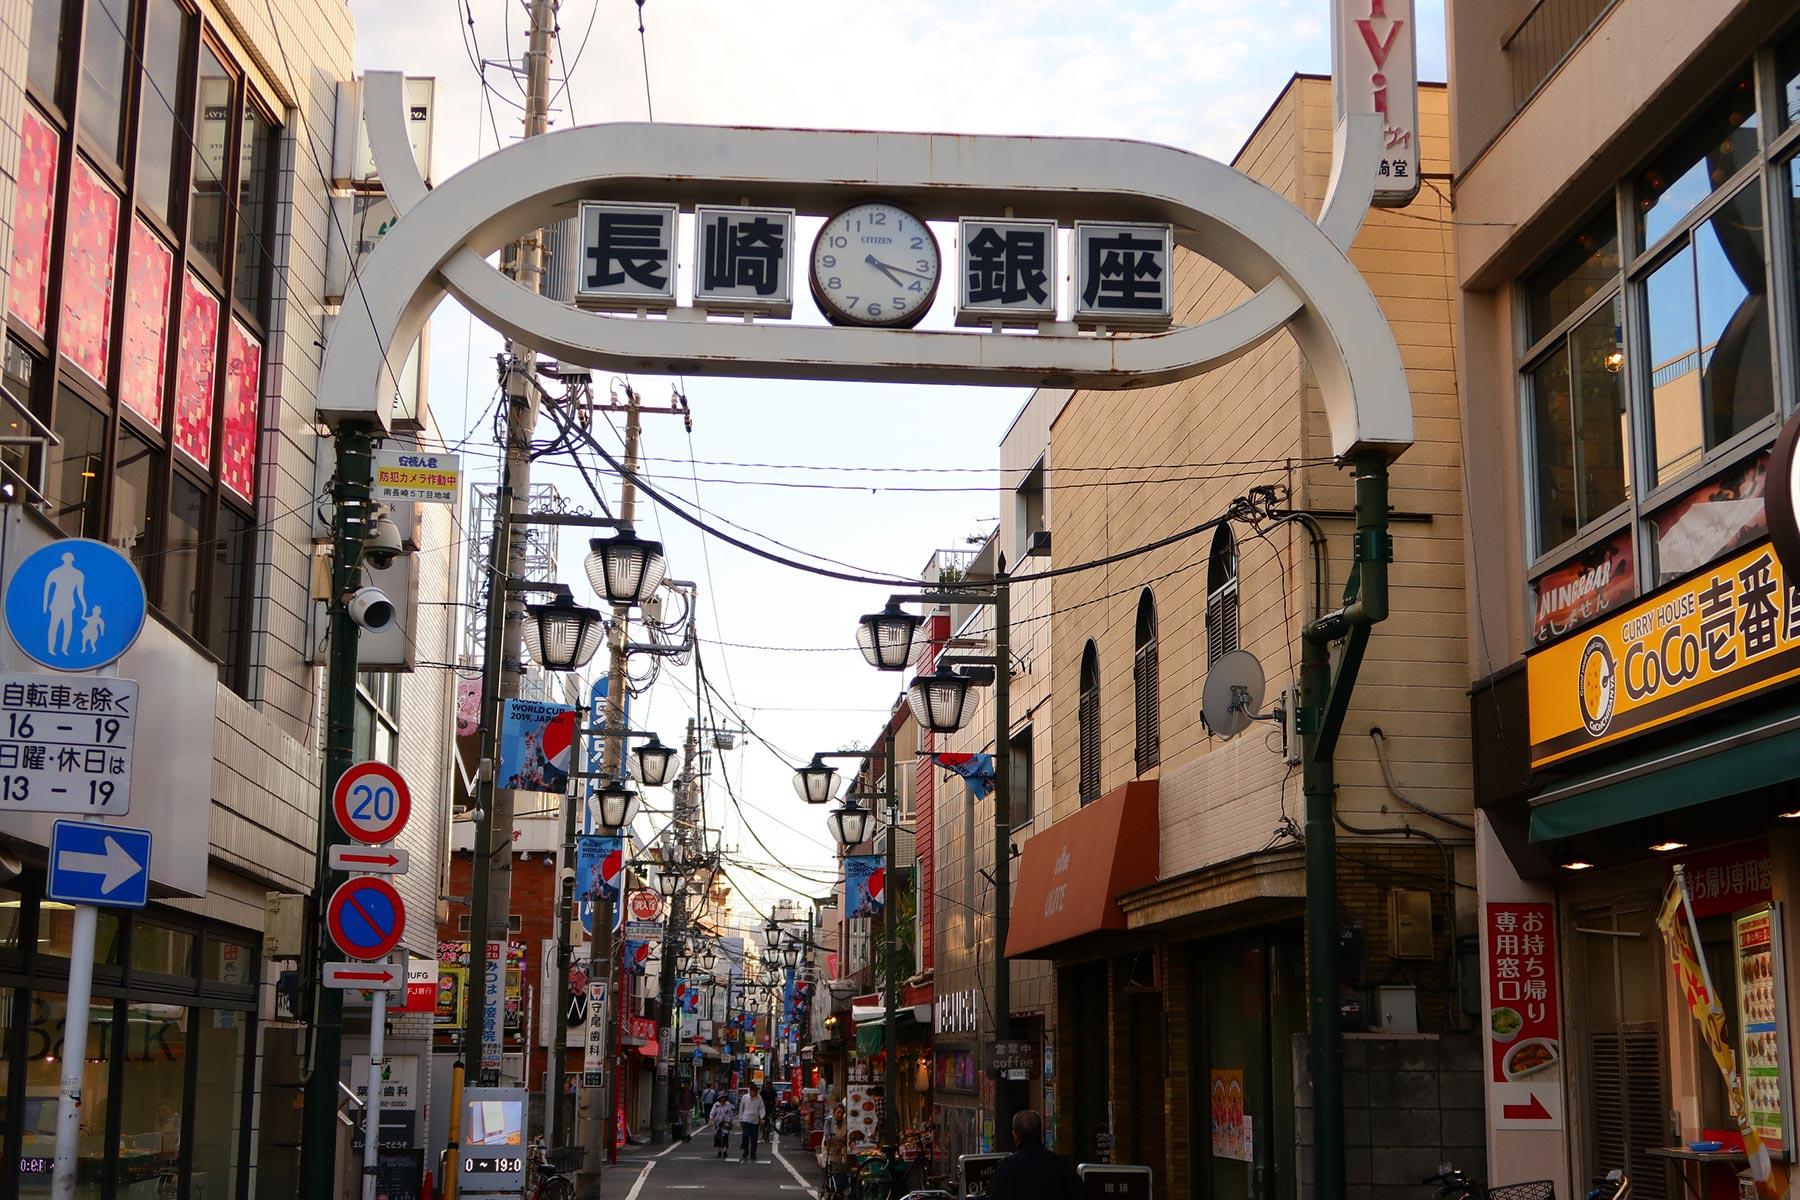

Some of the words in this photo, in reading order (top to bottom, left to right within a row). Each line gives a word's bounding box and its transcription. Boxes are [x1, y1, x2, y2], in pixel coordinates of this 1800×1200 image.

[1354, 0, 1404, 124] Vi
[845, 219, 861, 232] 11
[869, 212, 886, 225] 12
[898, 219, 903, 231] 1
[829, 235, 848, 248] 10
[861, 235, 893, 245] CITIZEN
[910, 236, 924, 250] 2
[822, 254, 837, 268] 9
[916, 259, 930, 273] 3
[827, 276, 842, 290] 8
[907, 280, 923, 294] 4
[845, 296, 860, 309] 7
[867, 303, 882, 316] 6
[892, 297, 907, 310] 5
[379, 471, 456, 487] 防犯カメラ作動中
[1622, 611, 1655, 643] CURRY
[1656, 592, 1695, 627] HOUSE
[3, 683, 131, 713] 自転車を除く
[512, 704, 545, 714] WORLD
[510, 713, 533, 722] 2019,
[536, 716, 564, 724] JAPAN
[9, 713, 35, 739] 16
[95, 718, 121, 744] 19
[3, 775, 30, 801] 13
[89, 780, 115, 806] 19
[352, 784, 395, 822] 20
[1495, 911, 1521, 1001] 専用窓口
[1521, 911, 1548, 1024] お持ち帰り
[993, 1055, 1033, 1069] coffee
[494, 1158, 521, 1172] 19:0
